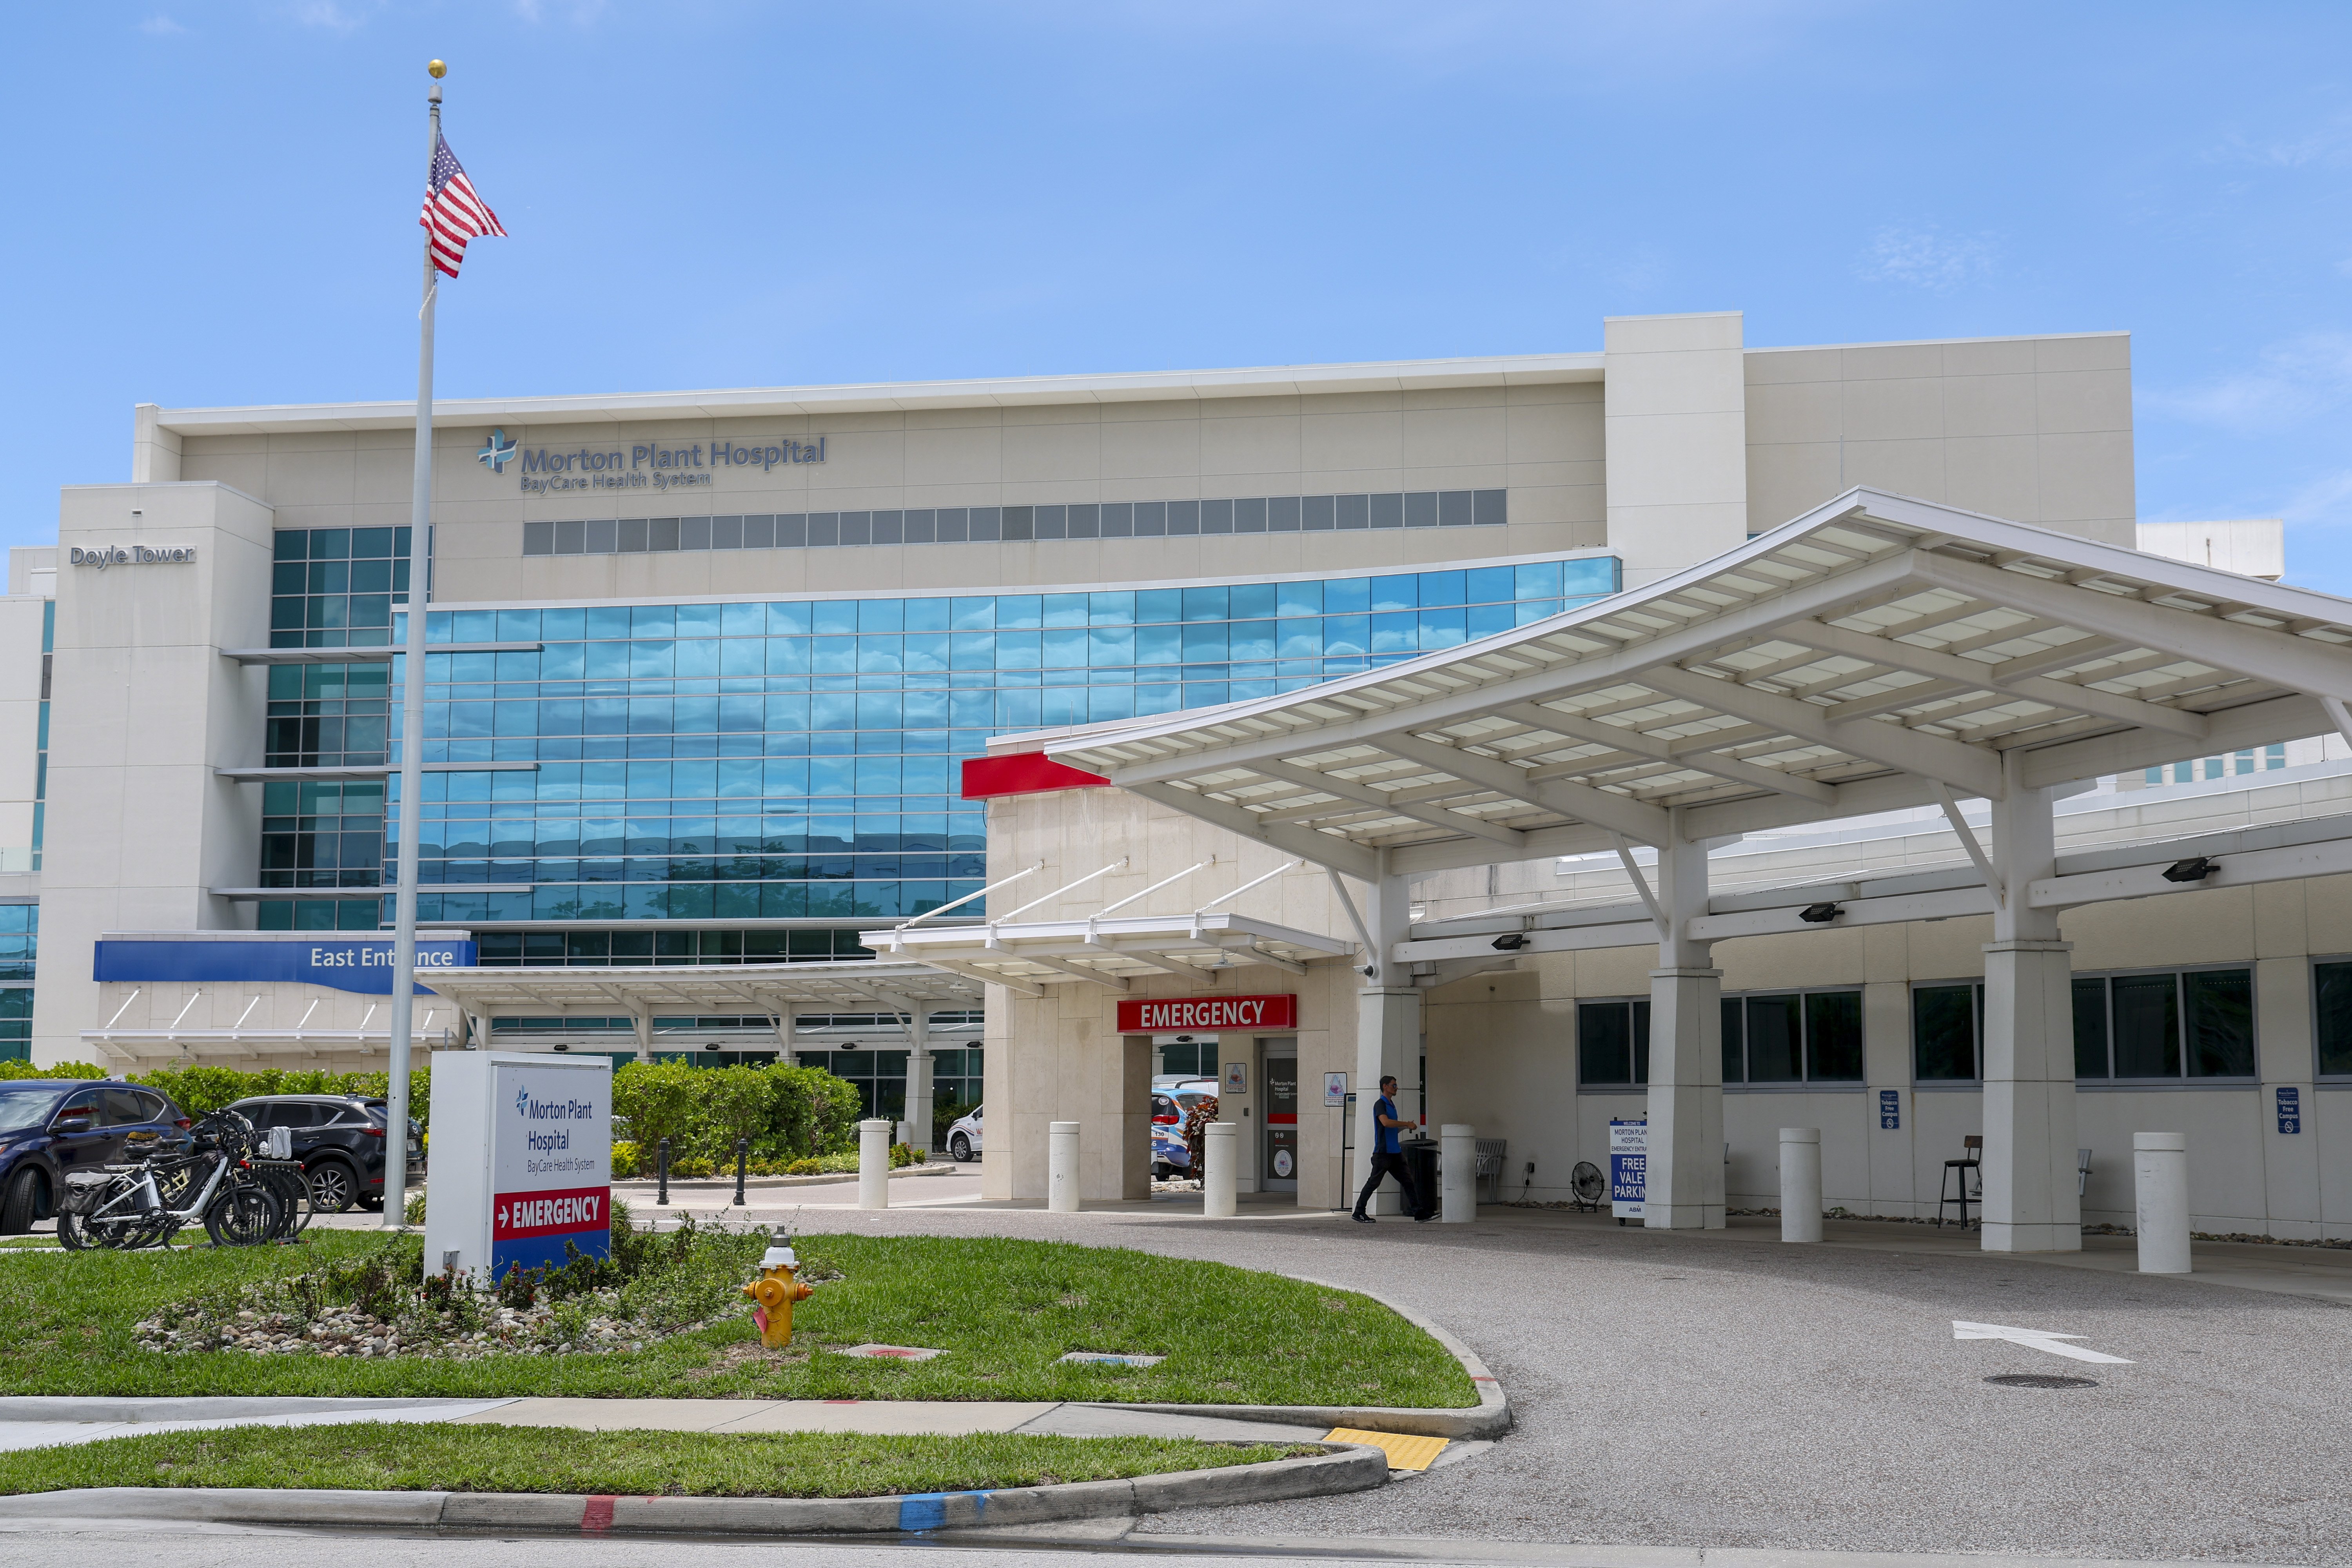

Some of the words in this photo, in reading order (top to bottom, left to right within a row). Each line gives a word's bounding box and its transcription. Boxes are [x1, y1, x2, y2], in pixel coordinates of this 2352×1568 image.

[521, 449, 624, 473] Morton
[632, 443, 702, 469] Plant
[710, 437, 826, 472] Hospital
[521, 475, 588, 495] BayCare
[592, 472, 648, 488] Health
[653, 472, 711, 491] System
[70, 545, 127, 569] Doyle
[132, 545, 194, 563] Tower
[311, 948, 355, 966] East
[361, 948, 453, 966] Entnce
[1141, 1000, 1265, 1027] EMERGENCY
[529, 1099, 566, 1120] Morton
[568, 1098, 592, 1120] Plant
[528, 1129, 569, 1156] Hospital
[528, 1159, 553, 1176] BayCare
[554, 1157, 573, 1171] Health
[574, 1158, 595, 1174] System
[1622, 1158, 1645, 1170] FREE
[1614, 1185, 1646, 1198] PARKIN
[513, 1196, 600, 1229] EMERGENCY
